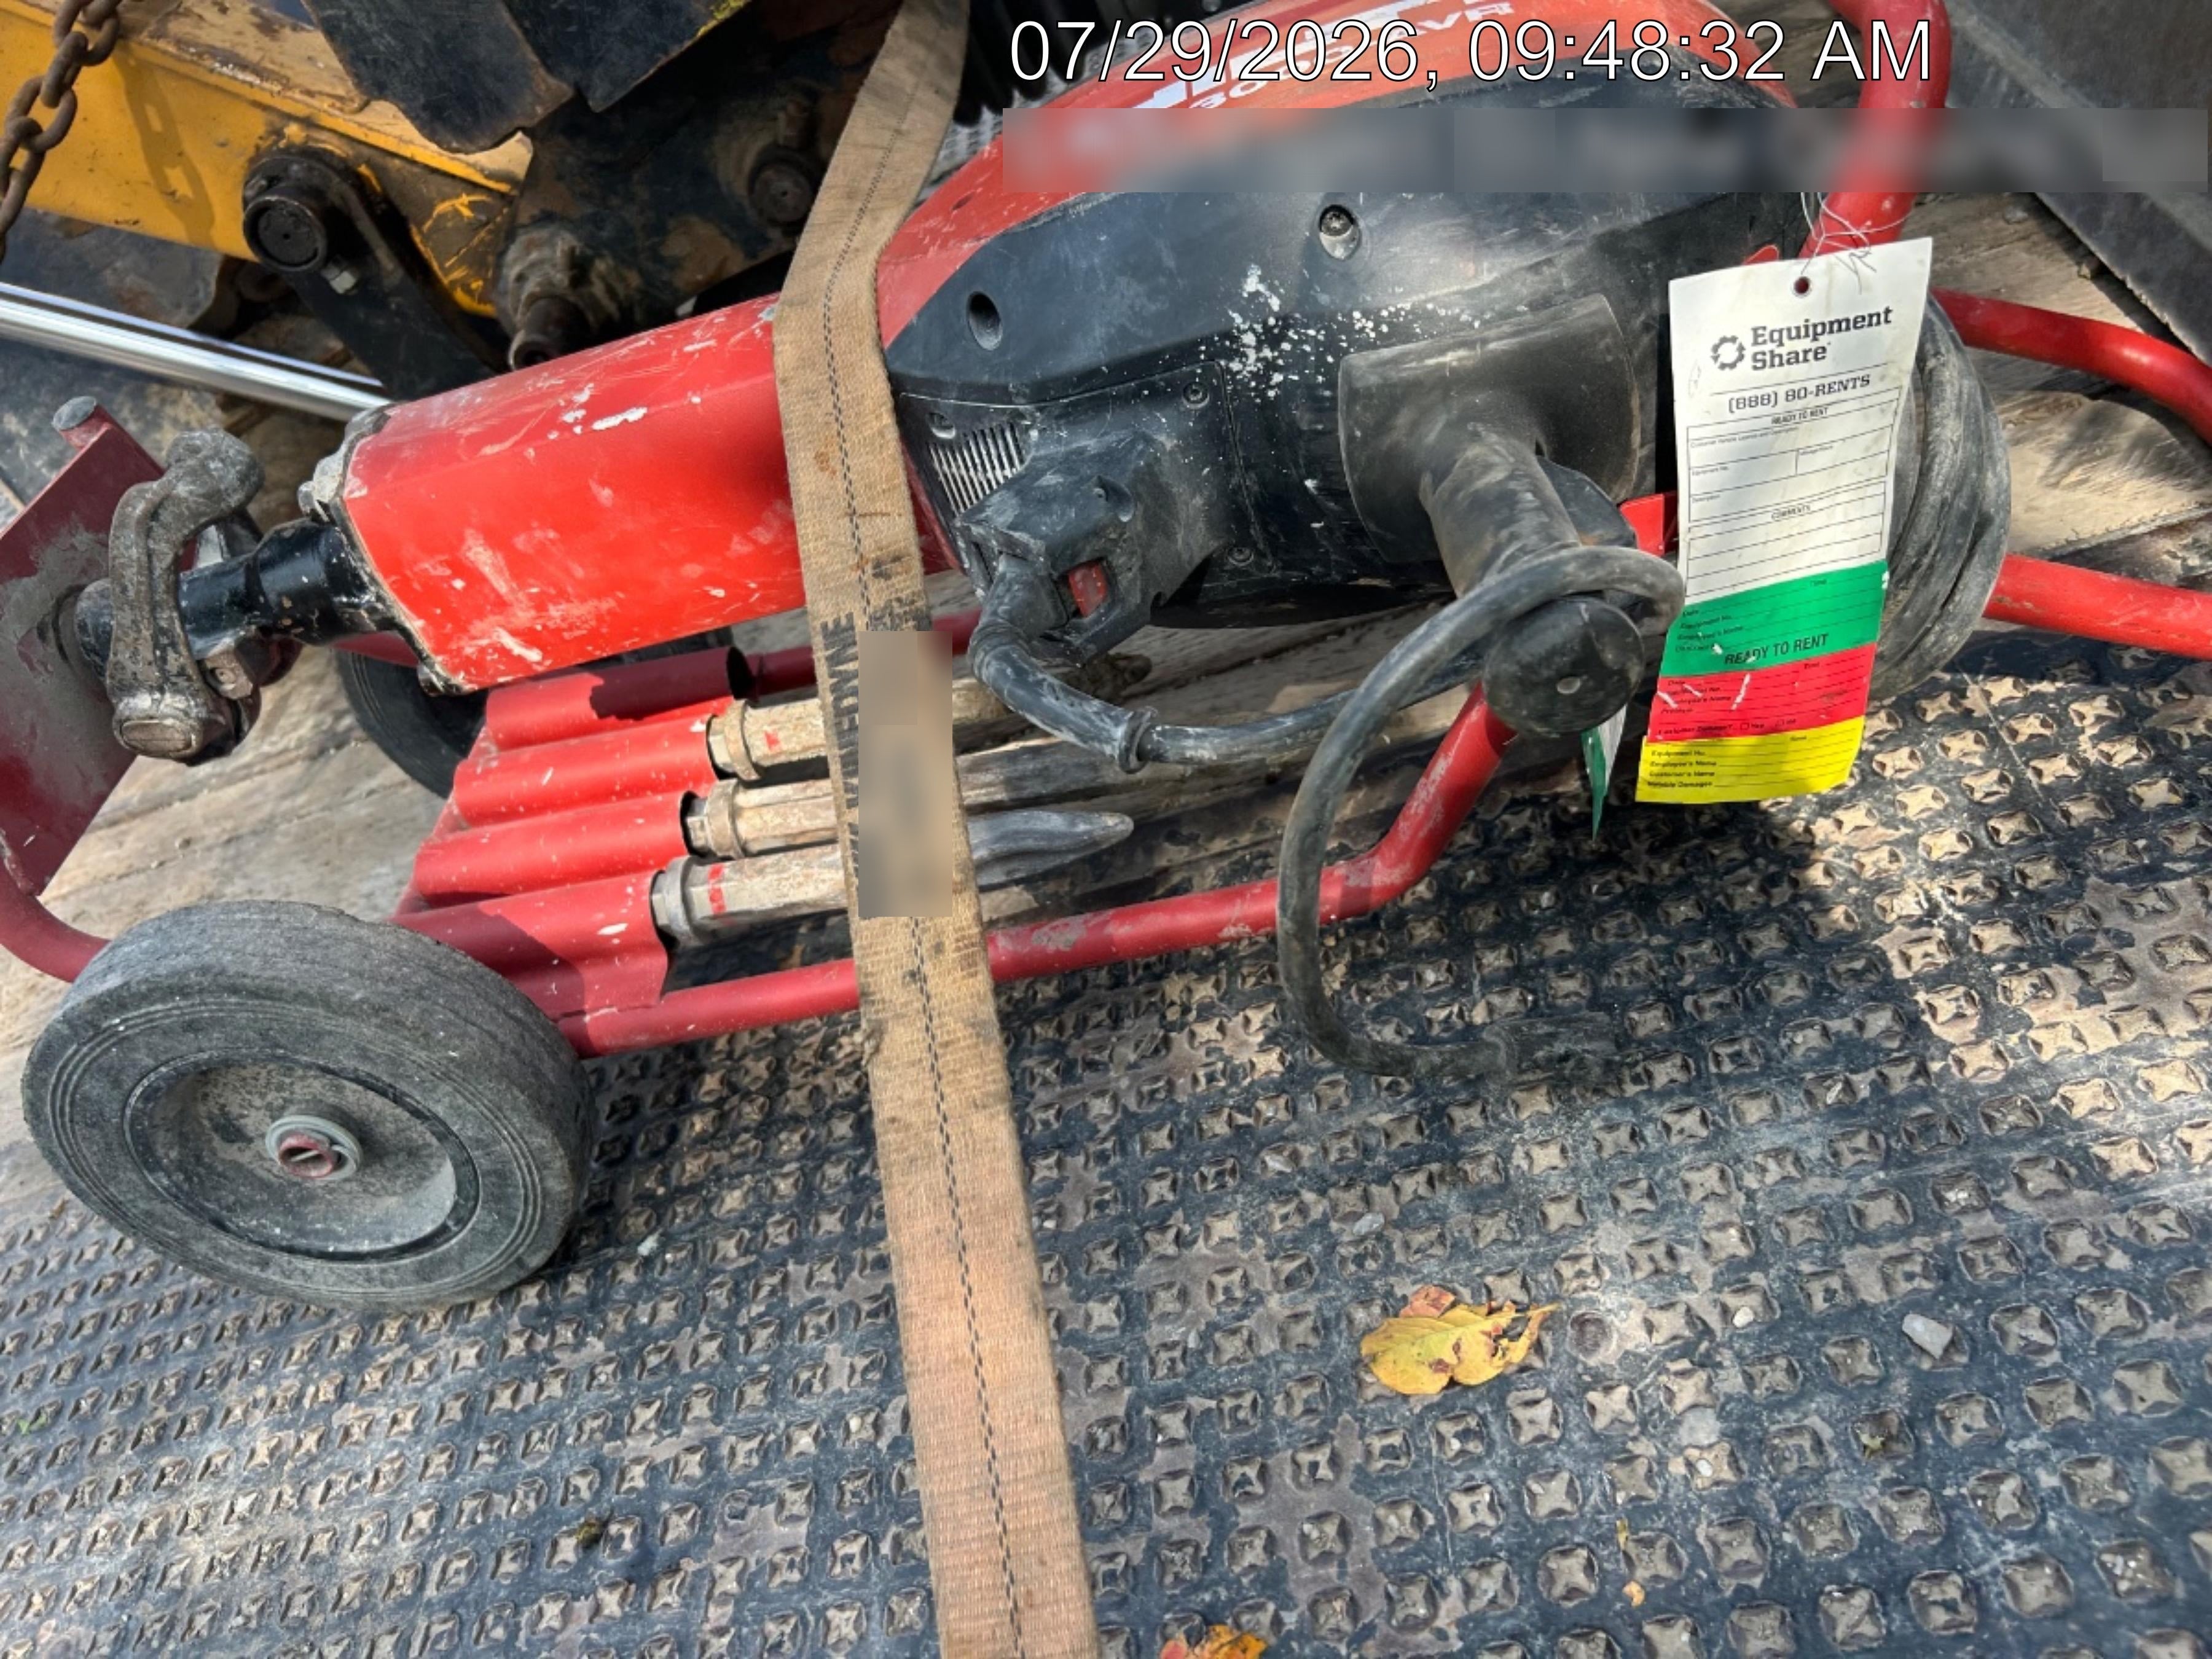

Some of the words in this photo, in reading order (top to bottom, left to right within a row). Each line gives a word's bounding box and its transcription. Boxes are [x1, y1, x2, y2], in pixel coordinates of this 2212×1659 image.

[1751, 306, 1892, 348] Equipment
[1751, 345, 1827, 371] Share
[1728, 391, 1778, 413] (888)
[1785, 374, 1870, 402] 80-RENTS
[1724, 646, 1769, 664] READY
[1773, 641, 1789, 656] TO
[1793, 633, 1829, 652] RENT
